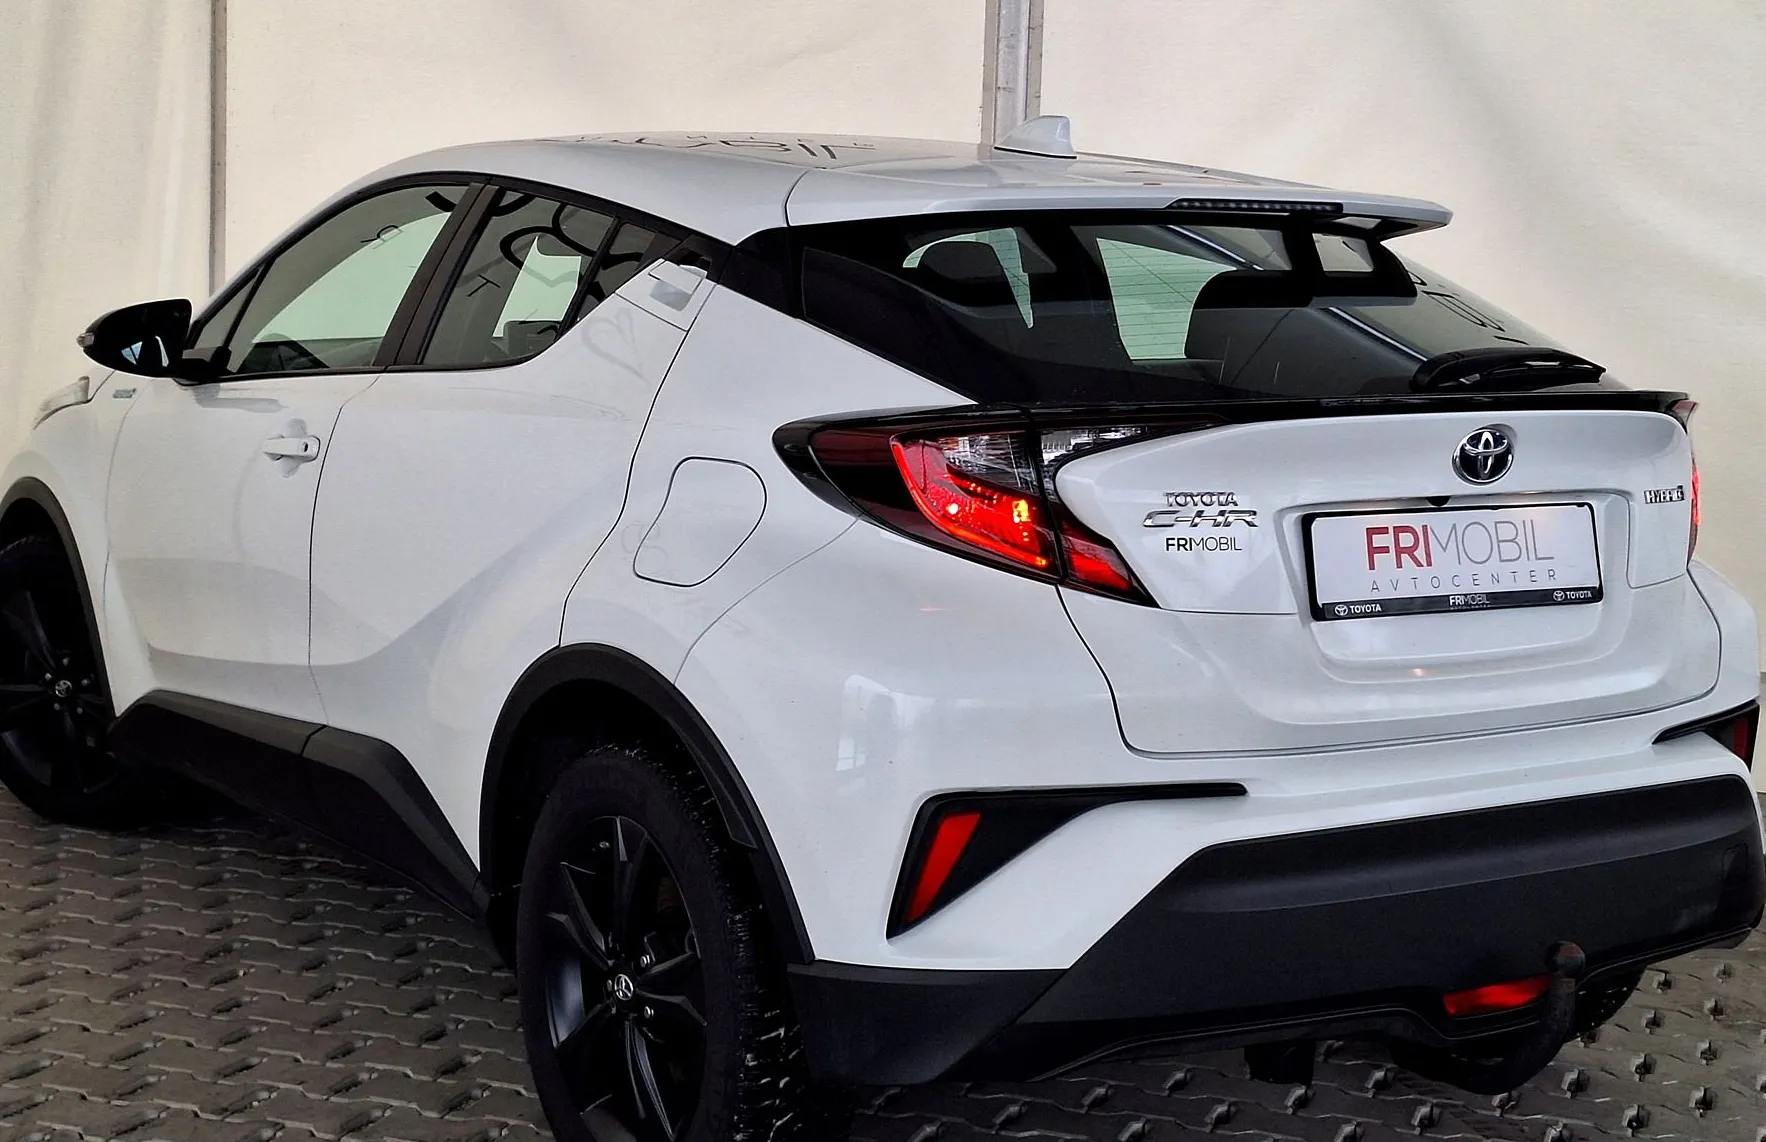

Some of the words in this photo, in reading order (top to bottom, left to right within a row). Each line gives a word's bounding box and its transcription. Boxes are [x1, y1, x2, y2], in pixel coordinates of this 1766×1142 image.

[1164, 491, 1238, 507] TOYOTA
[1143, 509, 1259, 528] C-HR
[1165, 536, 1243, 552] FRIMOBIL
[1365, 519, 1555, 571] FRIMOBIL
[1370, 568, 1557, 593] AVTOCENTER
[1566, 591, 1592, 599] TOYOTA
[1349, 603, 1382, 614] TOYOTA
